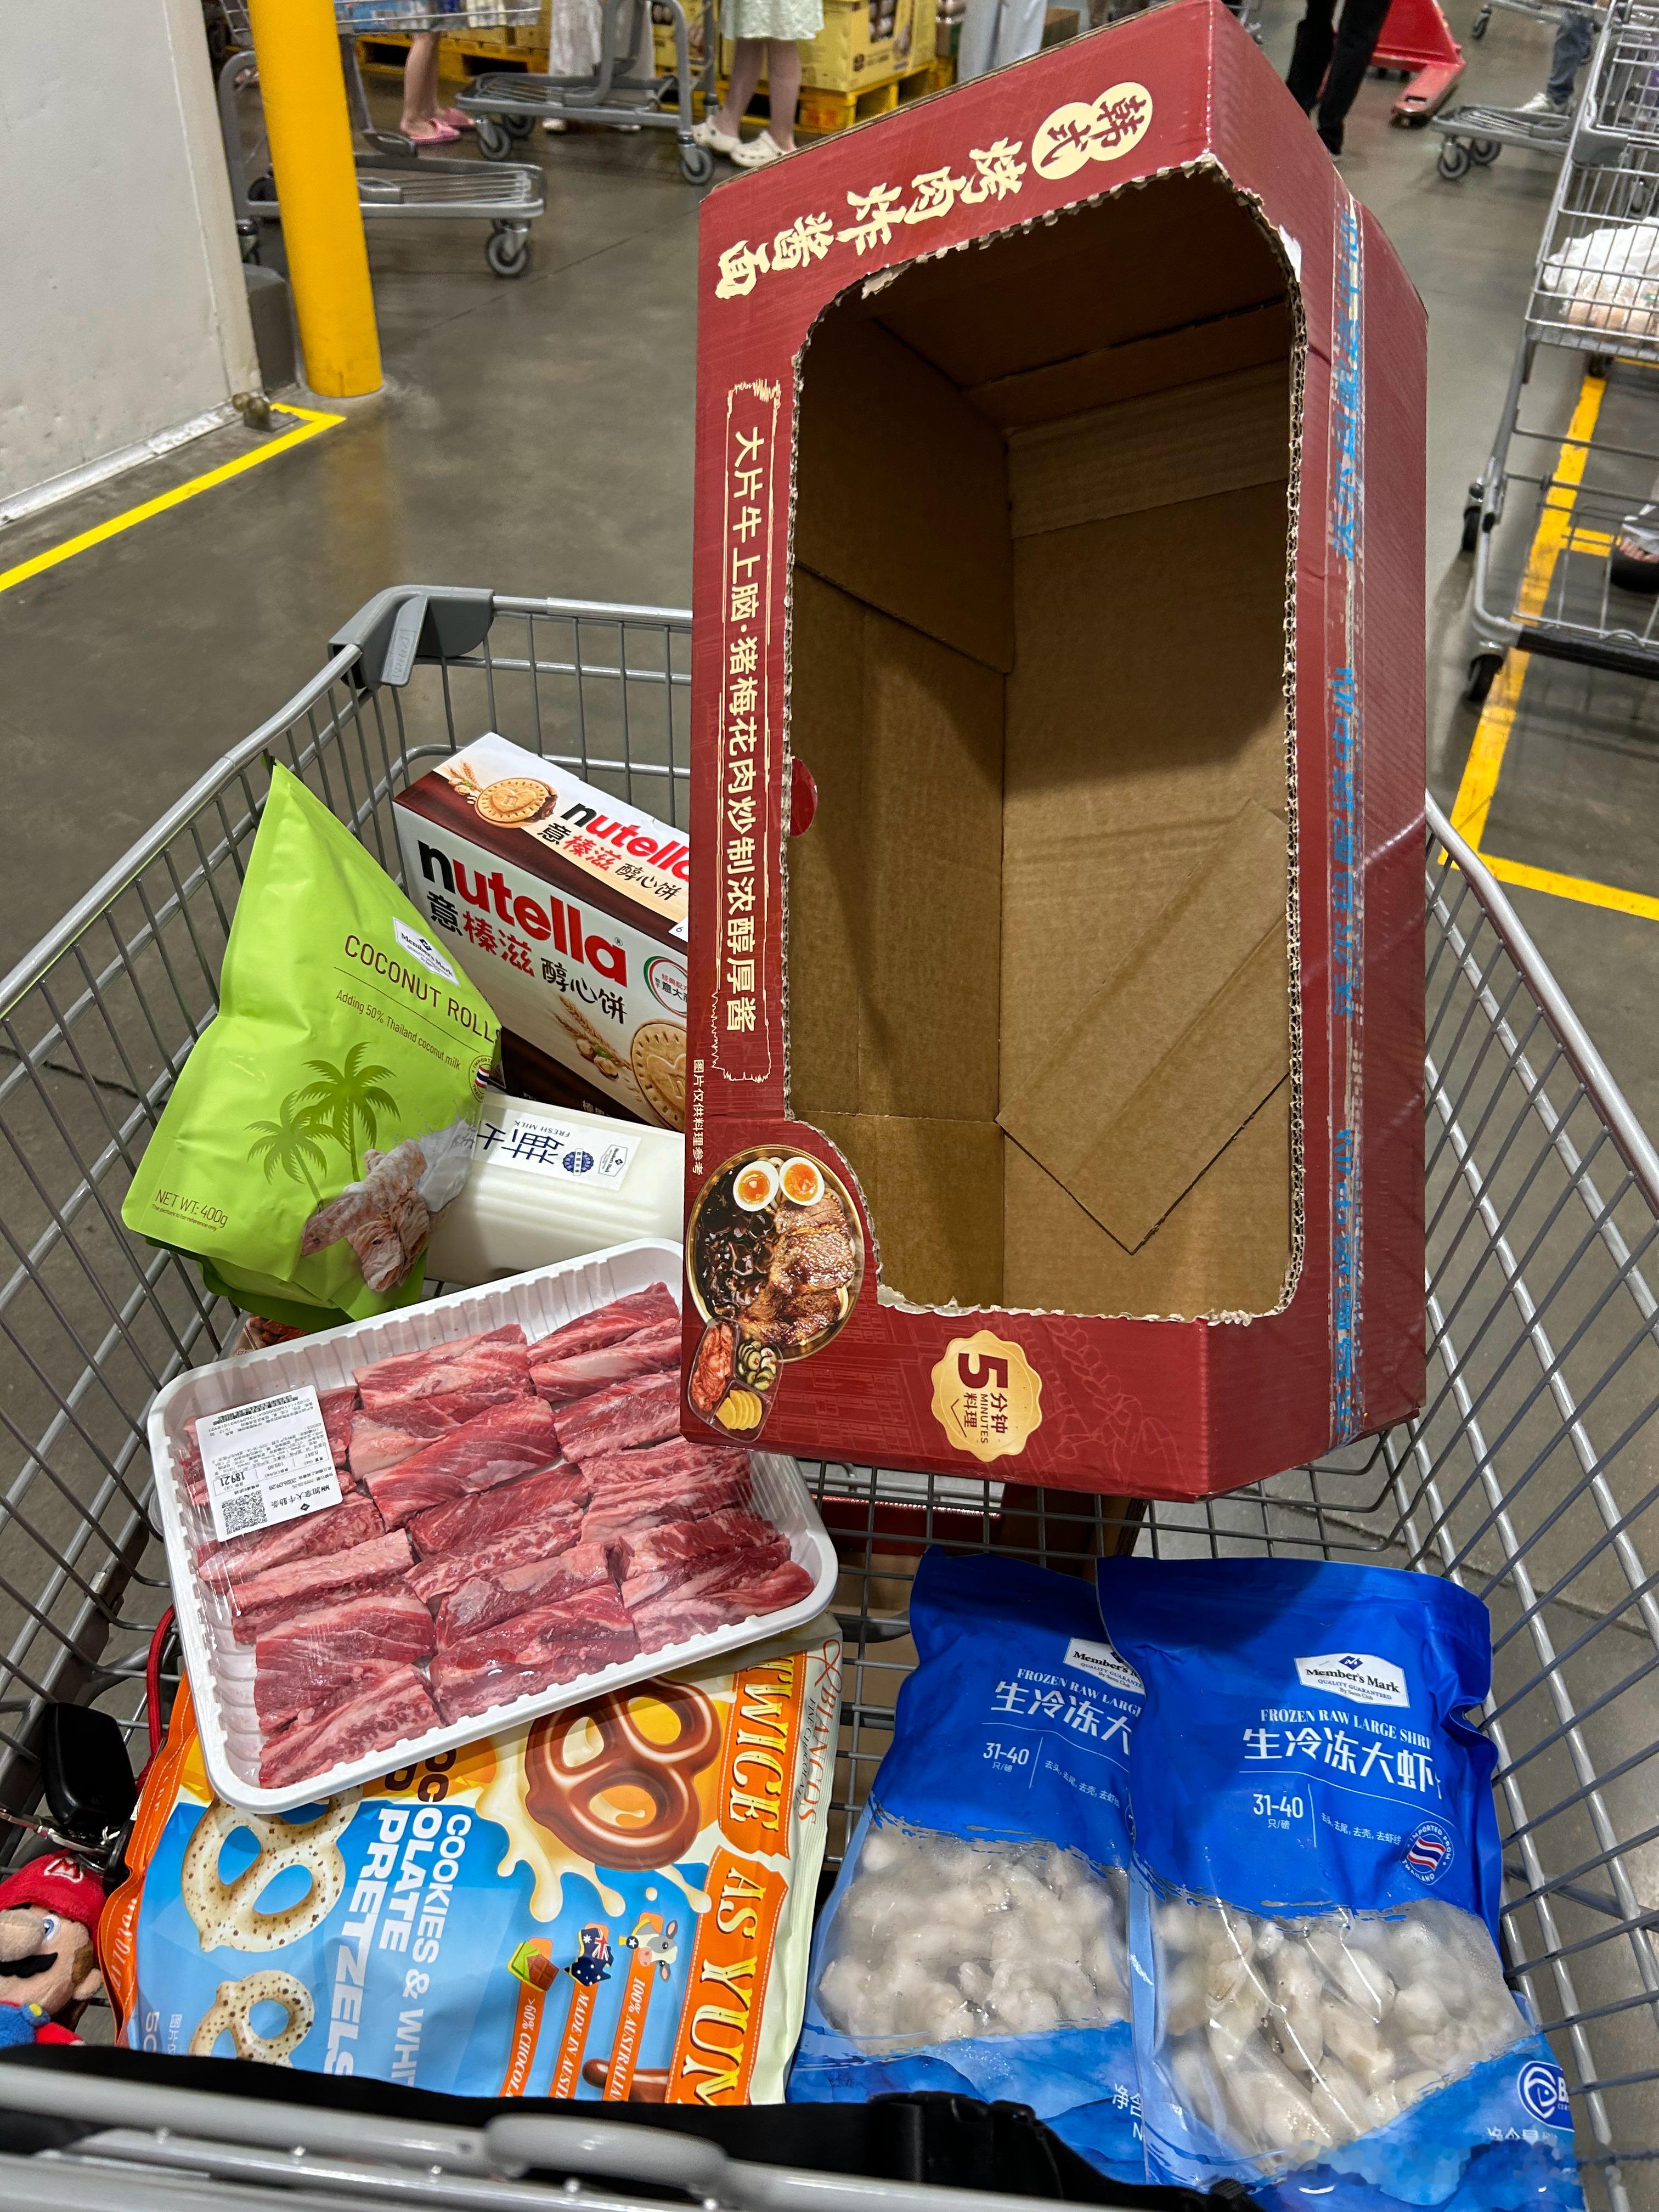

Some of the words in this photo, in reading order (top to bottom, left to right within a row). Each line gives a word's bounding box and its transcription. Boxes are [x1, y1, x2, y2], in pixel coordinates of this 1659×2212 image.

[1040, 95, 1147, 168] 韩式
[715, 137, 1028, 299] 烤肉炸酱面
[561, 803, 689, 882] nutella
[615, 863, 680, 900] 醇心饼
[417, 839, 628, 988] nutella
[345, 935, 442, 1008] COCONUT
[427, 890, 535, 978] 意榛滋
[541, 957, 628, 1025] 醇心饼
[336, 990, 364, 1014] Adding
[366, 1005, 383, 1024] 50%
[387, 1015, 417, 1042] Thailand
[418, 1037, 444, 1060] coconut
[445, 1051, 461, 1070] milk
[473, 1057, 493, 1069] IMPORT
[514, 1120, 539, 1130] MILK
[543, 1126, 571, 1137] FRESH
[692, 1059, 704, 1175] 图片仅供料理参考
[155, 1189, 180, 1207] NET
[180, 1197, 199, 1215] WT:
[201, 1205, 228, 1228] 400g
[958, 1353, 1008, 1389] 5
[963, 1392, 978, 1427] 料理
[980, 1394, 989, 1443] MINUTES
[990, 1393, 1008, 1434] 分钟
[219, 1471, 245, 1487] 189.21
[1073, 1651, 1128, 1673] Member's
[1080, 1663, 1108, 1673] QUALITY
[1017, 1668, 1068, 1687] FROZEN
[1070, 1681, 1100, 1699] RAW
[1306, 1669, 1365, 1683] Member's
[1366, 1675, 1401, 1694] Mark
[1318, 1679, 1347, 1688] QUALITY
[1348, 1684, 1392, 1700] GUARANTEED
[806, 1697, 816, 1729] FINE
[991, 1680, 1132, 1756] 生冷冻大
[1260, 1708, 1315, 1722] FROZEN
[1319, 1709, 1349, 1725] RAW
[1353, 1716, 1396, 1739] LARGE
[730, 1655, 794, 1831] TWICE
[983, 1742, 1030, 1765] 31-40
[1243, 1727, 1442, 1800] 生冷冻大虾
[1253, 1793, 1304, 1819] 31-40
[1268, 1819, 1290, 1830] 只/磅
[379, 1748, 456, 1953] OCOLATE
[1410, 1825, 1443, 1842] IMPORTED
[1443, 1836, 1452, 1860] FROM
[413, 1814, 472, 1963] COOKIES
[1402, 1859, 1435, 1882] THAILAND
[717, 1867, 766, 1939] AS
[324, 1808, 410, 2075] PRETZELS
[403, 1969, 430, 1999] &
[628, 1976, 646, 2015] 100%
[572, 1990, 589, 2036] MADE
[567, 2035, 579, 2057] IN
[610, 2014, 636, 2101] AUSTRALIA
